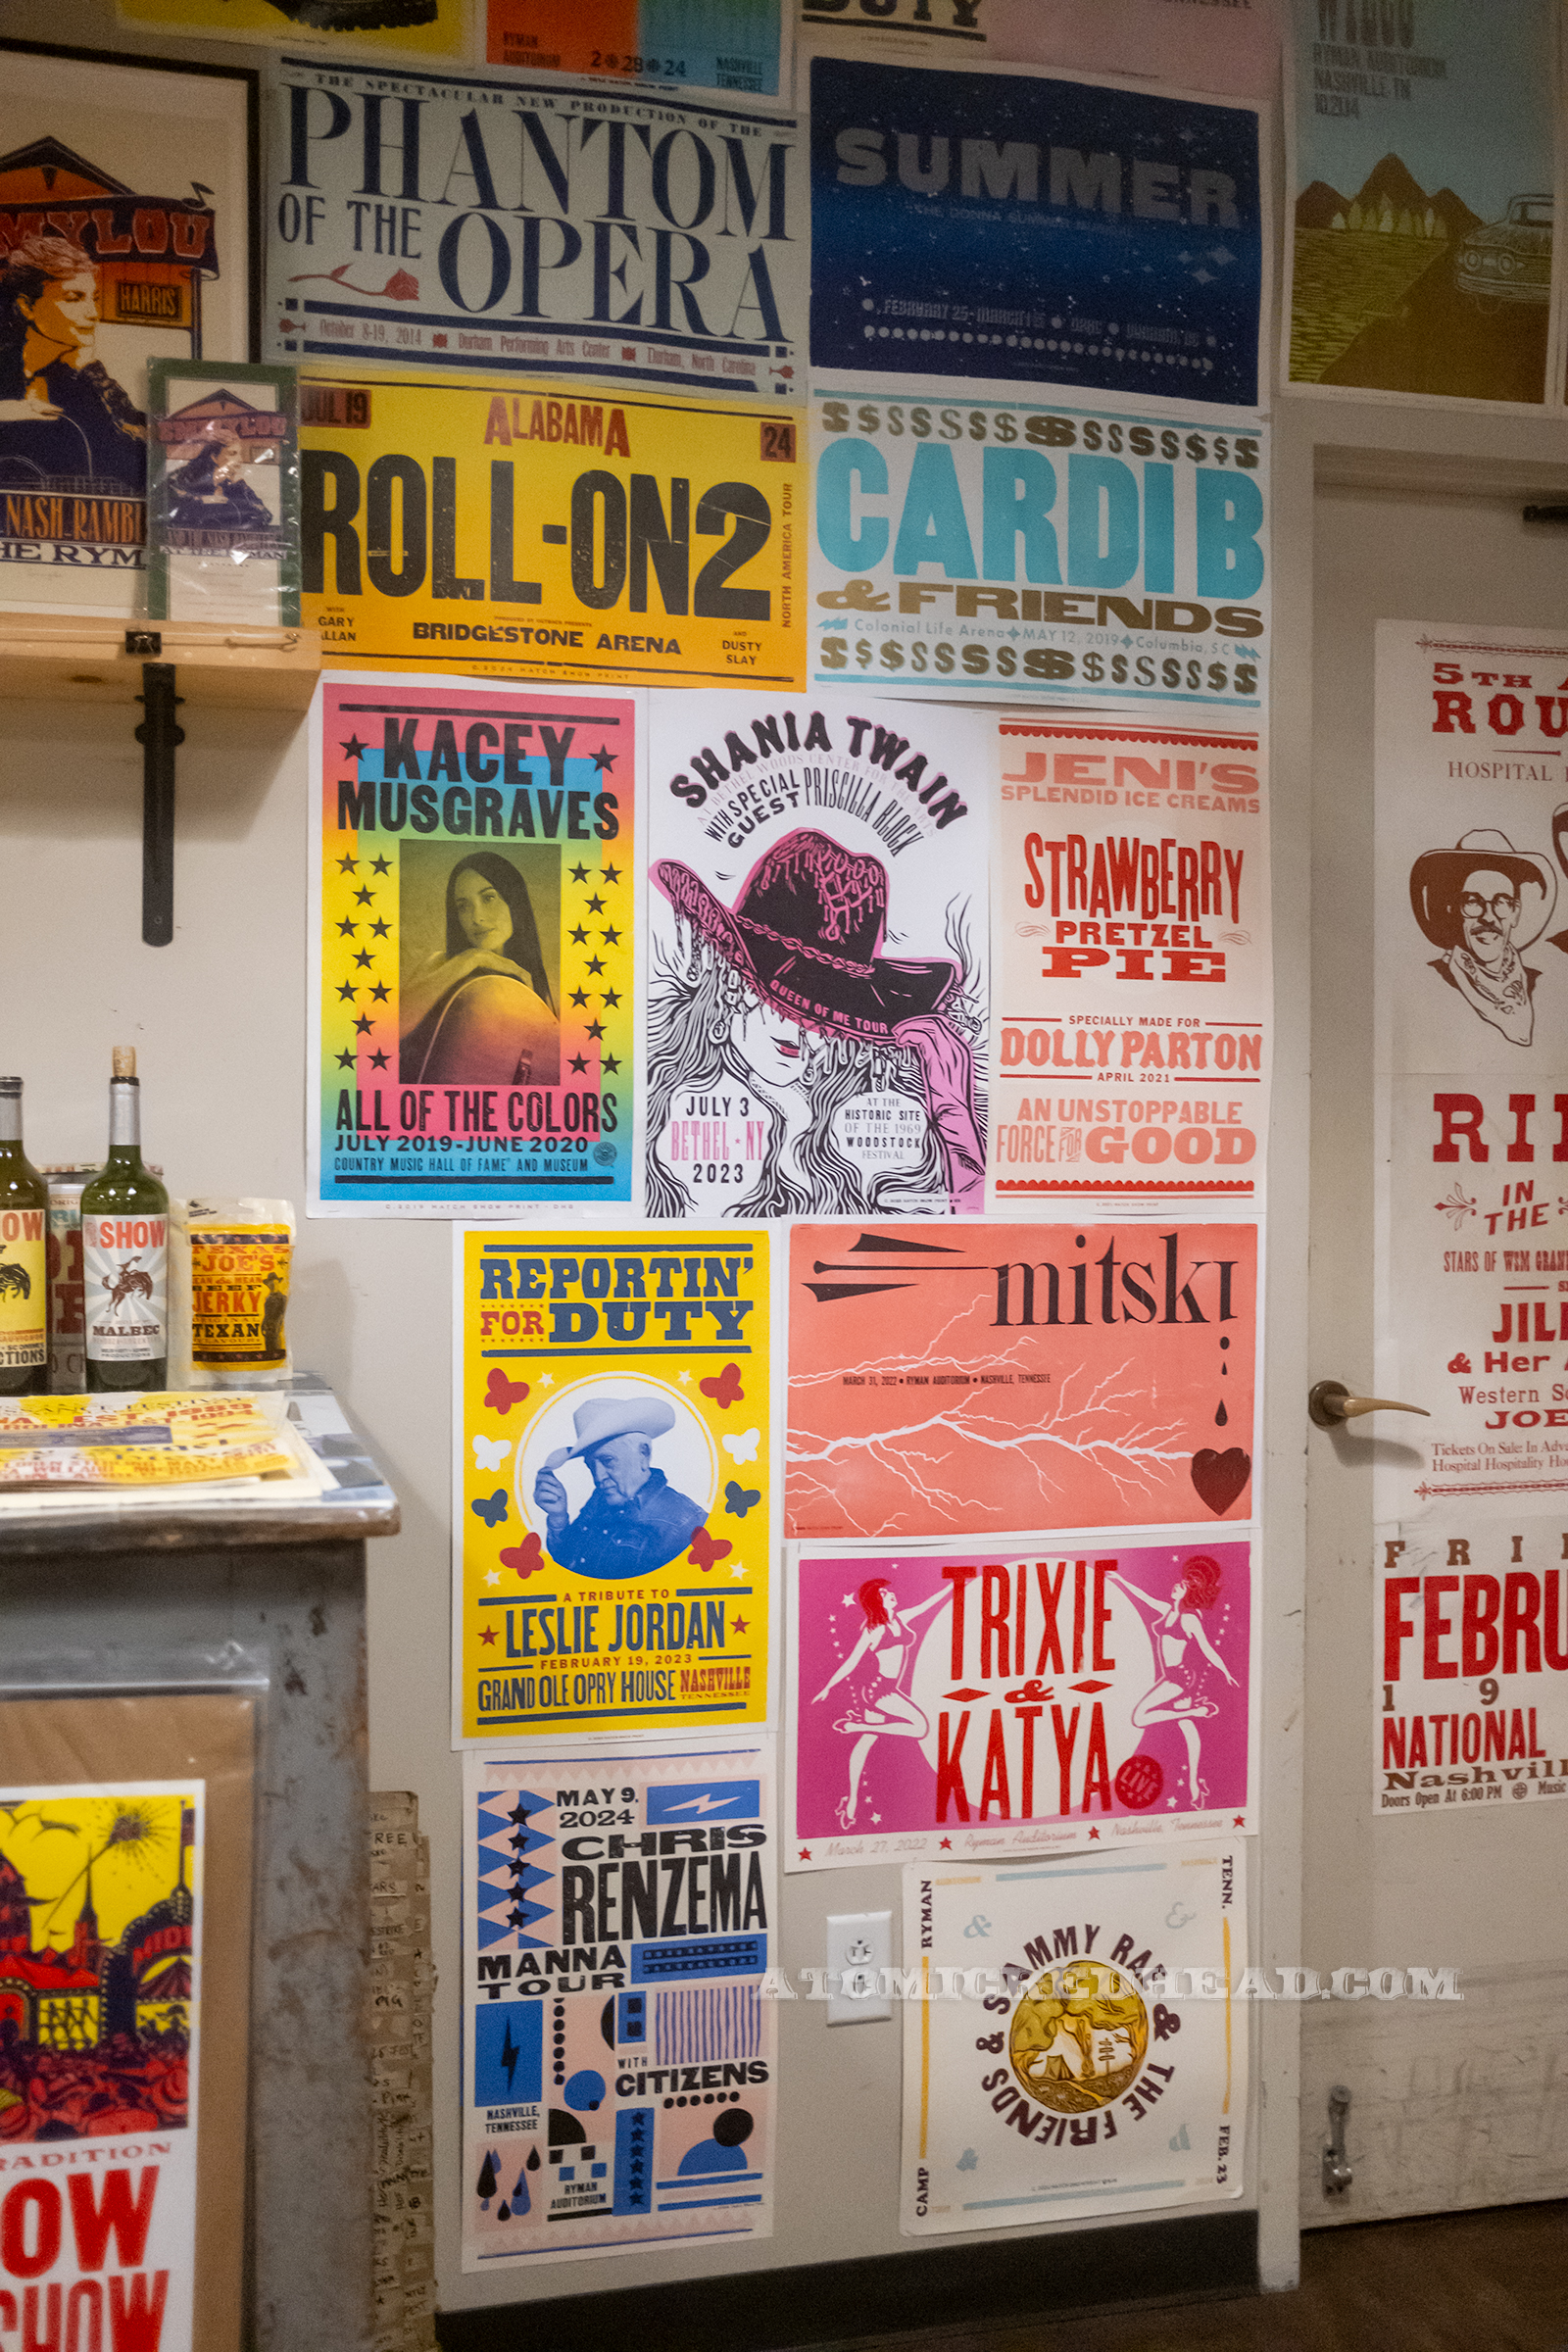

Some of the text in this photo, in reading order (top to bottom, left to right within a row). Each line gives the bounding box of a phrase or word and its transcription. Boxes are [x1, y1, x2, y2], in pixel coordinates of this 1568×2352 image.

[366, 79, 504, 105] SPECTACULAR
[515, 96, 557, 111] NEW
[569, 99, 687, 124] PRODUCTION
[729, 122, 762, 138] THE
[279, 81, 797, 241] PHANTOM
[834, 126, 1241, 230] SUMMER
[278, 192, 422, 260] OF THE
[438, 211, 795, 344] OPERA
[120, 282, 176, 316] HARRIS
[345, 391, 368, 424] 19
[483, 395, 632, 458] ALABAMA
[763, 424, 792, 459] 24
[6, 494, 64, 539] NASH
[816, 437, 1265, 602] CARDI B
[301, 447, 772, 622] ROLL-ON2
[781, 482, 793, 628] NORTH AMERICA TOUR
[318, 615, 355, 628] GARY
[815, 578, 1265, 639] & FRIENDS
[413, 621, 584, 649] BRIDGESTONE
[596, 633, 682, 656] ARENA
[721, 639, 762, 654] DUSTY
[854, 618, 922, 637] Colonial
[924, 620, 955, 637] Life
[958, 622, 1006, 640] Arena
[1022, 627, 1056, 643] MAY
[1087, 632, 1119, 647] 2019
[1136, 636, 1207, 655] Columbia,
[725, 653, 758, 666] SLAY
[1433, 662, 1533, 689] 5TH
[383, 716, 576, 786] KACEY
[669, 710, 969, 830] SHANIA TWAIN
[1002, 752, 1260, 795] JENI'S
[1447, 761, 1552, 781] HOSPITAL
[337, 780, 619, 841] MUSGRAVES
[704, 766, 925, 858] WITH SPECIAL GUEST PRISCILLA BLOCK
[1001, 785, 1260, 814] SPLENDID ICE CREAMS
[1024, 832, 1245, 924] STRAWBERRY
[1055, 920, 1213, 949] PRETZEL
[1042, 946, 1227, 983] PIE
[769, 979, 889, 1035] QUEEN OF ME TOUR
[1068, 1015, 1201, 1028] SPECIALLY MADE FOR
[1000, 1027, 1263, 1071] DOLLY PARTON
[1097, 1072, 1171, 1083] APRIL 2021
[334, 1088, 618, 1133] ALL OF THE COLORS
[686, 1097, 750, 1117] JULY 3
[845, 1109, 921, 1121] HISTORIC SITE
[867, 1098, 902, 1107] AT THE
[1016, 1098, 1244, 1125] AN UNSTOPPABLE
[334, 1134, 589, 1153] JULY 2019-JUNE 2020
[670, 1120, 764, 1161] BETHEL NY
[845, 1123, 921, 1135] OF THE 1969
[846, 1137, 921, 1149] WOODSTOCK
[996, 1124, 1056, 1163] FORCE
[1085, 1126, 1257, 1165] GOOD
[334, 1156, 384, 1172] COUNTRY
[390, 1156, 423, 1172] MUSIC
[428, 1157, 455, 1172] HALL
[461, 1157, 474, 1172] OF
[516, 1157, 538, 1172] AND
[543, 1157, 589, 1172] MUSEUM
[693, 1163, 745, 1184] 2023
[1502, 1179, 1534, 1206] IN
[100, 1220, 166, 1249] SHOW
[1484, 1202, 1549, 1236] THE
[192, 1245, 291, 1254] TEXAS
[201, 1254, 275, 1272] JOE'S
[1444, 1250, 1531, 1273] STARS OF WSM
[479, 1256, 755, 1299] REPORTIN'
[989, 1232, 1240, 1327] mitski
[192, 1291, 262, 1313] JERKY
[92, 1325, 160, 1337] MALBEC
[192, 1323, 260, 1338] TEXAN
[480, 1300, 754, 1343] FOR DUTY
[1447, 1350, 1550, 1374] & Her
[1458, 1386, 1540, 1405] Western
[1431, 1440, 1538, 1457] Tickets On Sale: In
[1433, 1455, 1544, 1474] Hospital Hospitality
[564, 1588, 670, 1602] A TRIBUTE TO
[506, 1600, 725, 1659] LESLIE JORDAN
[941, 1559, 1118, 1680] TRIXIE
[540, 1653, 693, 1671] FEBRUARY 19, 2023
[477, 1669, 676, 1712] GRAND OLE OPRY HOUSE
[680, 1666, 752, 1693] NASHVILLE
[680, 1690, 751, 1700] TENNESSEE
[1004, 1679, 1055, 1704] &
[1383, 1707, 1546, 1770] NATIONAL
[935, 1701, 1113, 1824] KATYA
[557, 1788, 615, 1807] MAY
[1120, 1765, 1158, 1801] LIVE
[1382, 1778, 1567, 1808] Doors Open At 6:00 PM Music
[560, 1809, 635, 1829] 2024
[562, 1824, 767, 1861] CHRIS
[562, 1851, 767, 1945] RENZEMA
[920, 1880, 933, 1948] RYMAN
[477, 1944, 627, 1982] MANNA
[983, 1924, 1101, 2015] SAMMY
[477, 1972, 625, 2000] TOUR
[1152, 2003, 1182, 2042] &
[975, 2031, 1005, 2055] &
[615, 2060, 769, 2096] CITIZENS
[617, 2056, 648, 2069] WITH
[980, 2067, 1119, 2146] FRIENDS
[1122, 2062, 1176, 2122] THE
[485, 2119, 538, 2134] TENNESSEE
[486, 2105, 540, 2121] NASHVILLE,
[564, 2181, 598, 2195] RYMAN
[1216, 2165, 1228, 2184] 23
[550, 2192, 607, 2209] AUDITORIUM
[915, 2166, 930, 2217] CAMP
